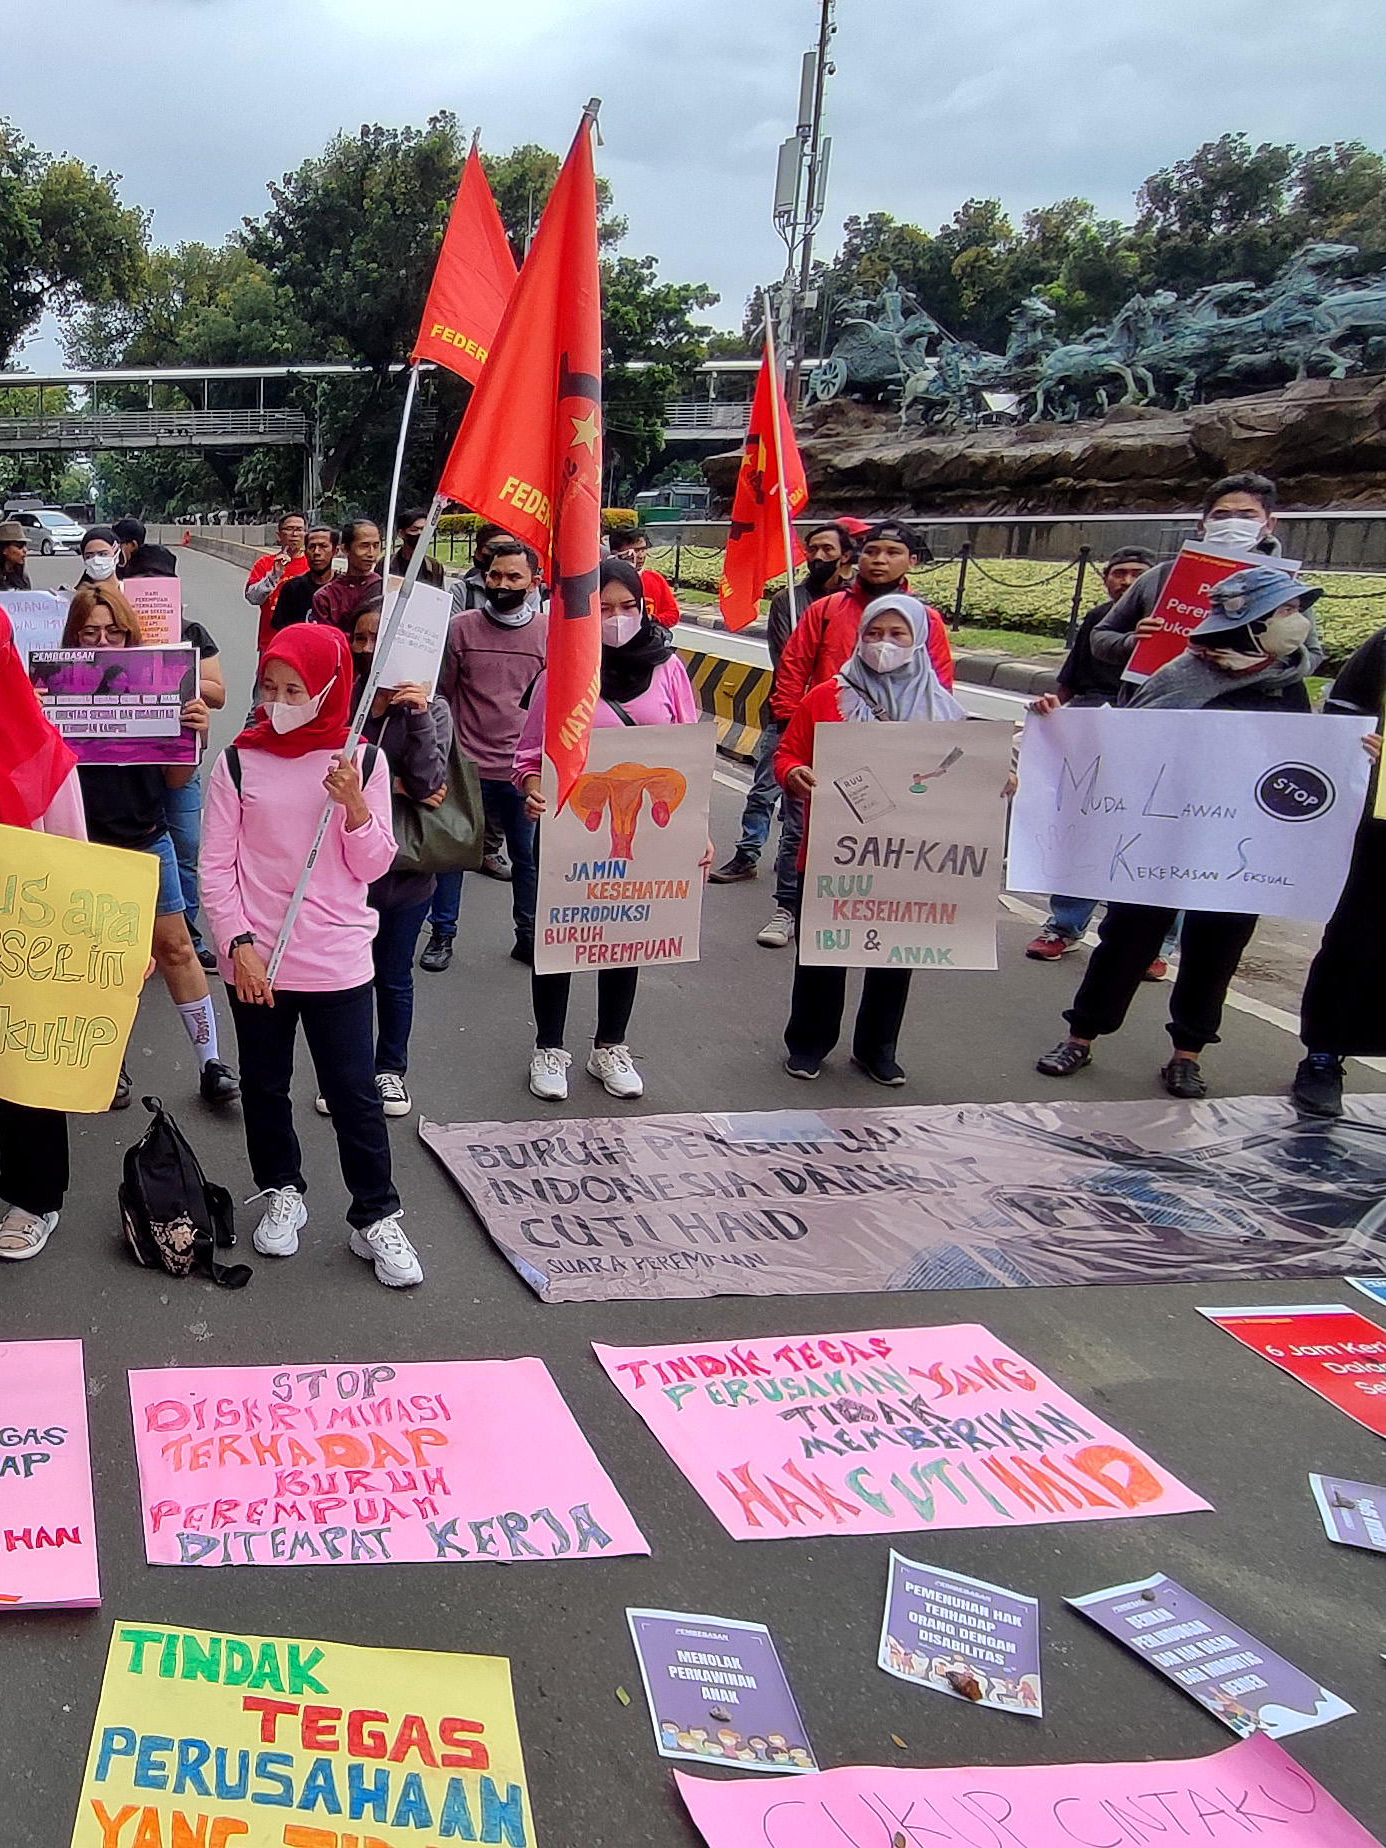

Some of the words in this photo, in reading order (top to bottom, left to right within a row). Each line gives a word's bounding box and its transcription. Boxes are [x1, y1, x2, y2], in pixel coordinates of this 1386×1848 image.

[843, 775, 864, 789] RUU
[1272, 777, 1319, 806] STOP
[564, 860, 628, 882] JAMIN
[833, 835, 989, 878] SAH-KAN
[587, 880, 690, 900] KESEHATAN
[817, 874, 874, 898] RUU
[62, 888, 141, 947] apa
[549, 904, 651, 924] REPRODUKSI
[832, 900, 958, 925] KESEHATAN
[544, 925, 604, 946] BURUH
[575, 936, 683, 964] PEREMPUAN
[815, 928, 851, 950] IBU
[864, 928, 881, 951] &
[886, 946, 955, 965] ANAK
[466, 1136, 638, 1169] BURUH
[486, 1170, 772, 1206] INDONESIA
[519, 1214, 663, 1248] CUTI
[672, 1208, 809, 1247] HAID
[548, 1256, 629, 1274] SUARA
[615, 1343, 766, 1390] TINDAK
[773, 1336, 893, 1378] TEGAS
[1264, 1345, 1285, 1357] 6
[1288, 1341, 1340, 1357] Jam
[272, 1365, 397, 1402] STOP
[907, 1354, 1037, 1401] YANG
[776, 1393, 950, 1432] TIDAK
[798, 1401, 1097, 1461] MEMBERIKAN
[161, 1428, 450, 1473] TERHADAP
[273, 1466, 452, 1499] BURUH
[715, 1456, 866, 1528] HAK
[844, 1455, 1016, 1523] CUTI
[978, 1444, 1164, 1515] HAID
[149, 1497, 441, 1534] PEREMPUAN
[177, 1526, 392, 1564] DITEMPAT
[426, 1503, 614, 1559] KERJA
[905, 1580, 990, 1618] PEMENUHAN
[993, 1609, 1023, 1628] HAK
[924, 1602, 997, 1632] TERHADAP
[908, 1611, 956, 1636] ORANG
[959, 1628, 1017, 1654] DENGAN
[918, 1629, 1005, 1665] DISABILITAS
[118, 1628, 329, 1696] TINDAK
[667, 1665, 757, 1690] PERKAWINAN
[676, 1649, 743, 1671] MENOLAK
[700, 1686, 740, 1705] ANAK
[241, 1695, 490, 1770] TEGAS
[94, 1727, 527, 1848] PERUSAHAAN
